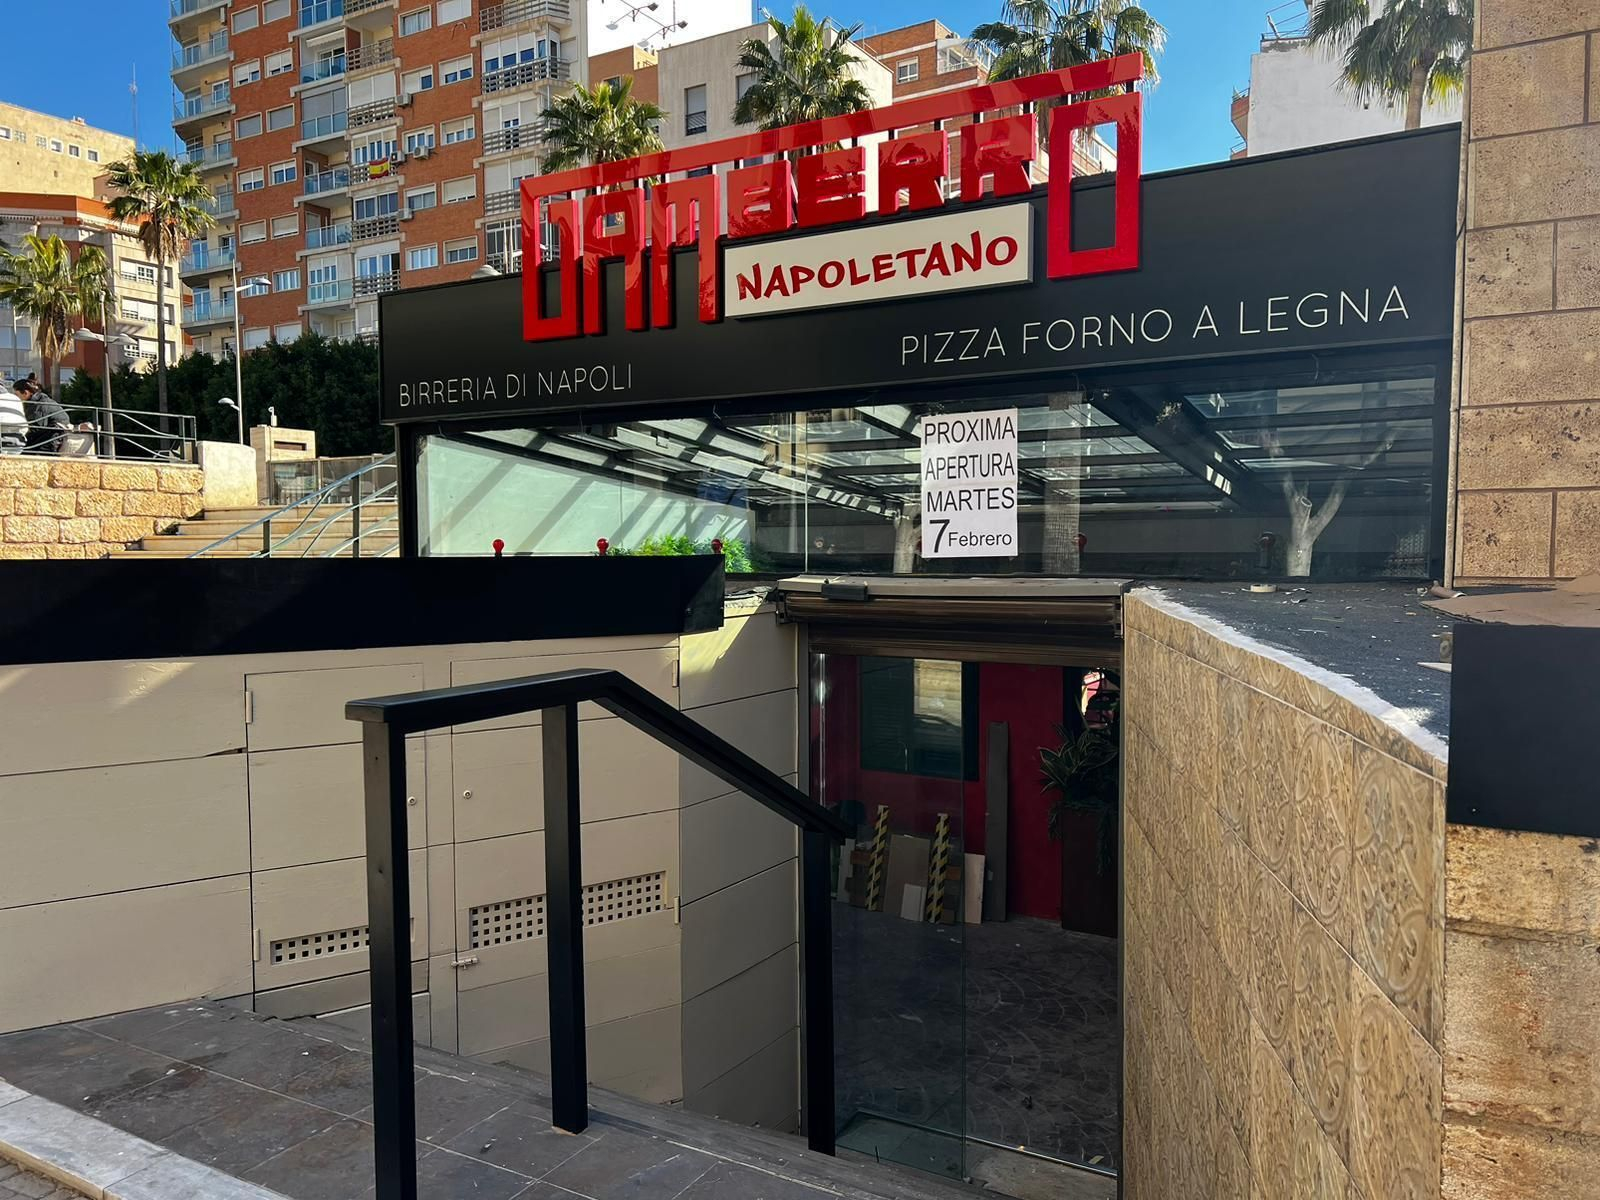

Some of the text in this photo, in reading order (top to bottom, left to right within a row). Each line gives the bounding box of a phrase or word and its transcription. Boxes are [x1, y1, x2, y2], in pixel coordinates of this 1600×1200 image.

[736, 230, 1018, 301] NAPOLETANO
[901, 285, 1410, 366] PIZZA FORNO A LEGNA
[399, 363, 632, 407] BIRRERIA DI NAPOLI
[924, 416, 1016, 445] PROXIMA
[925, 452, 1015, 481] APERTURA
[927, 487, 1015, 513] MARTES
[929, 519, 1012, 553] 7 Febrero
